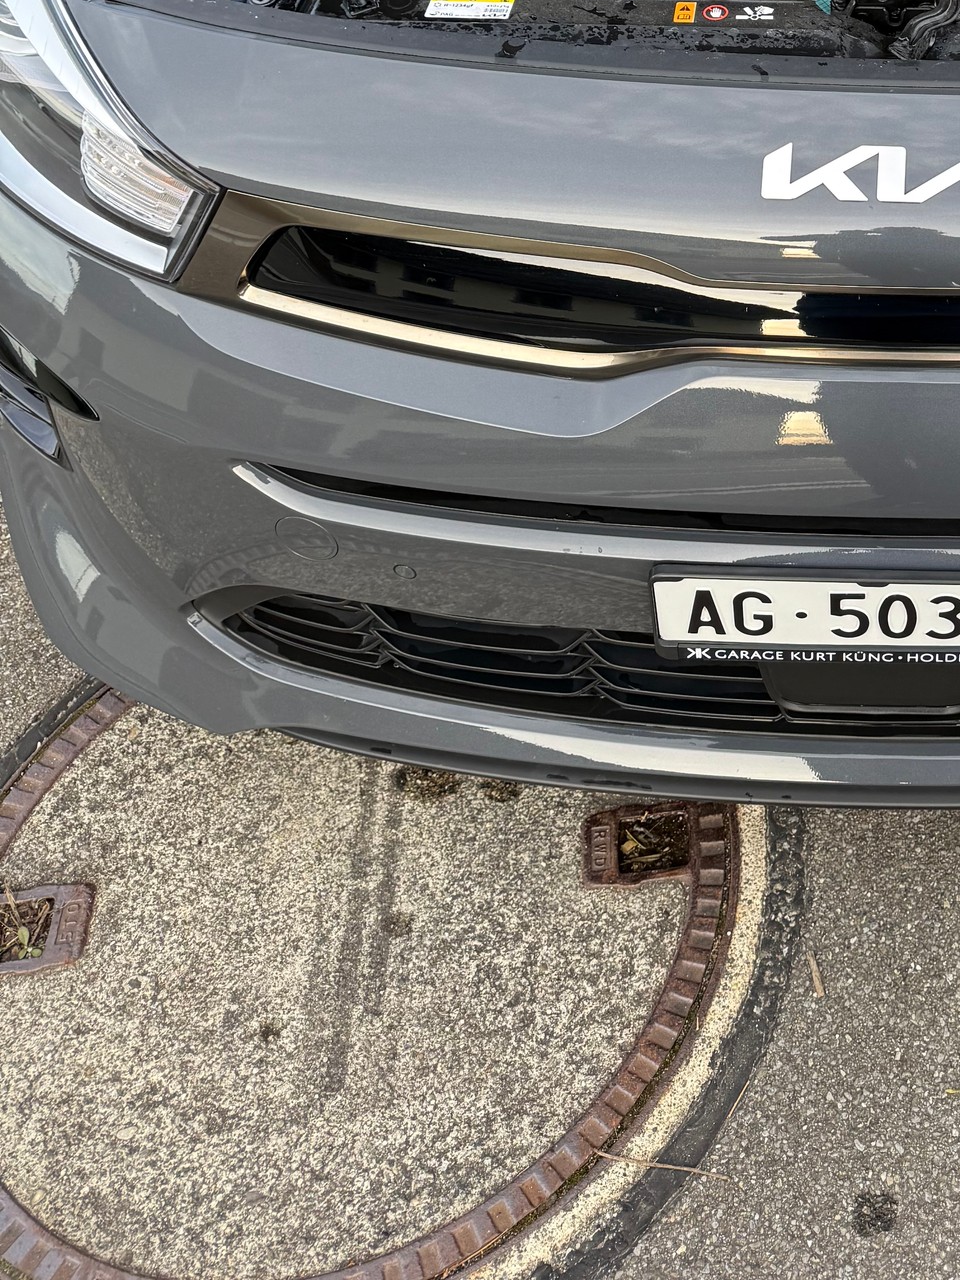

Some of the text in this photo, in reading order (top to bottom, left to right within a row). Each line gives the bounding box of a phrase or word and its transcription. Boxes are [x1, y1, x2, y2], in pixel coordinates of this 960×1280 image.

[687, 589, 775, 636] AG
[715, 649, 784, 661] GARAGE
[790, 651, 836, 662] KURT
[842, 651, 894, 663] KÜNG
